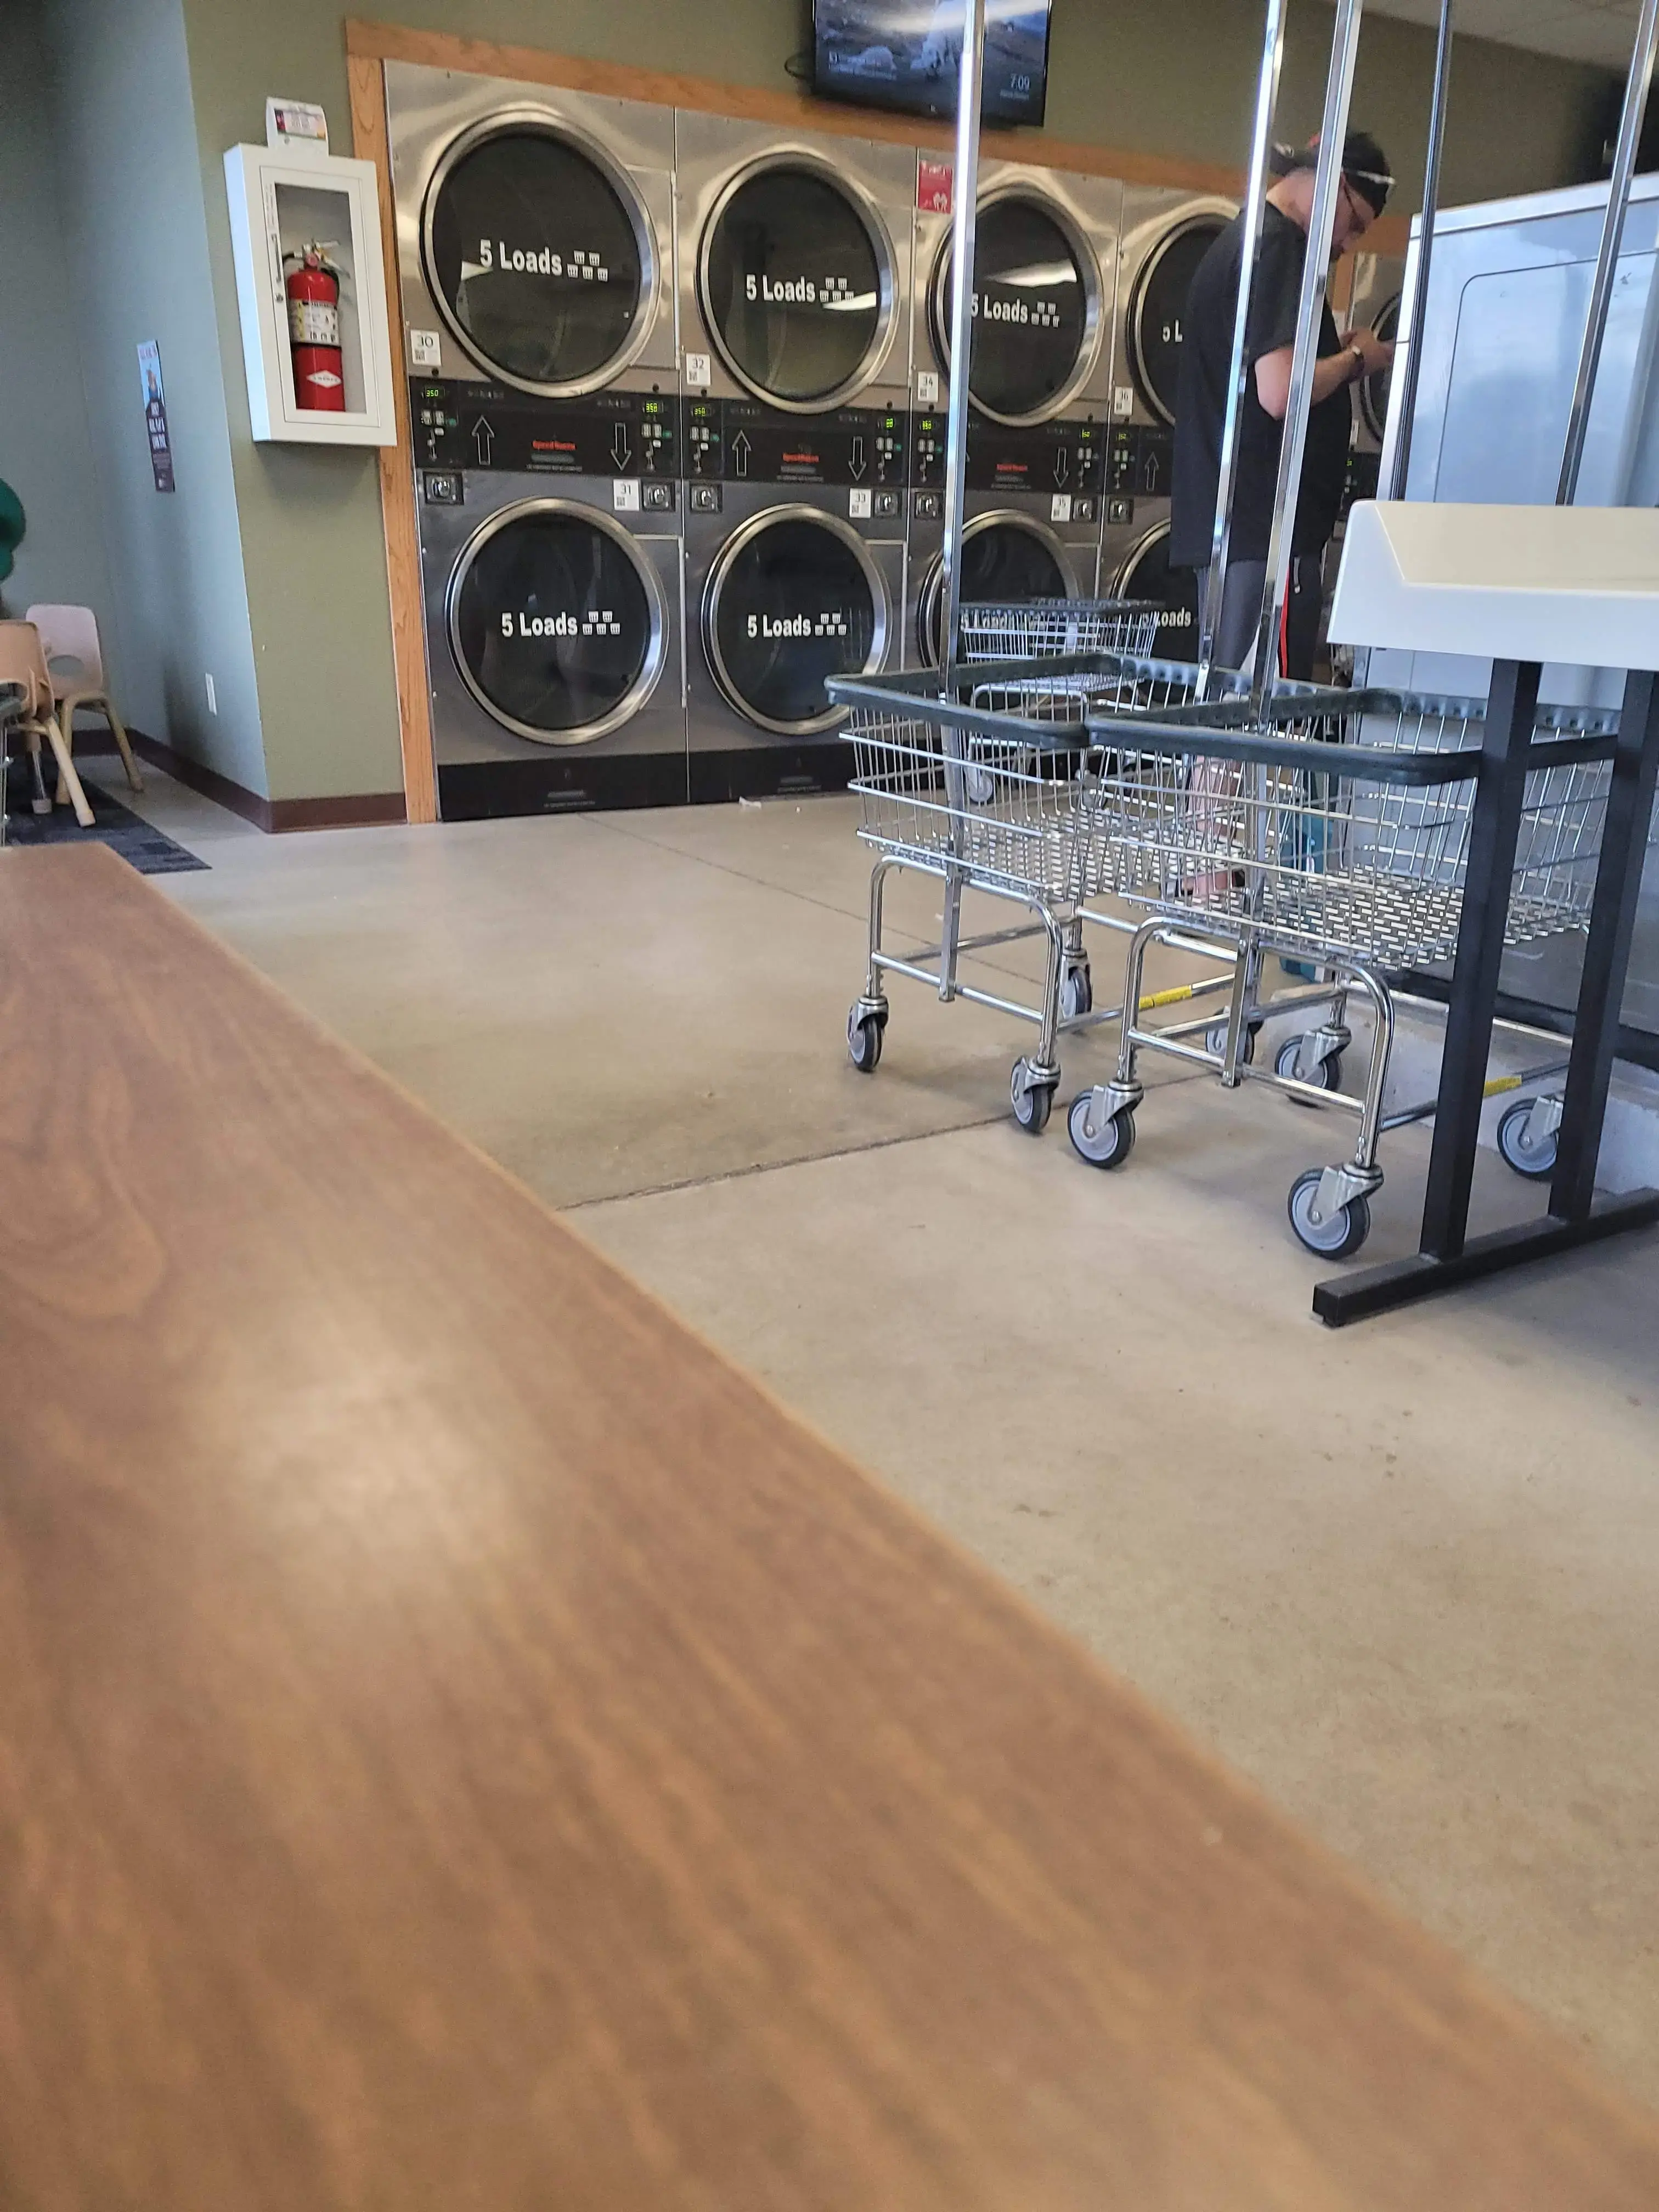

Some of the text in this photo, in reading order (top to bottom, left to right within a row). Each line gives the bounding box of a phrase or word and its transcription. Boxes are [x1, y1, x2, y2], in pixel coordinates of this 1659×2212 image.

[479, 239, 563, 276] 5 Loads
[746, 274, 816, 303] 5 Loads
[970, 293, 1028, 324] 5 Loads
[692, 358, 704, 370] 32
[922, 376, 933, 388] 34
[620, 483, 631, 495] 31
[501, 612, 578, 637] 5 Loads
[747, 614, 812, 637] 5 Loads
